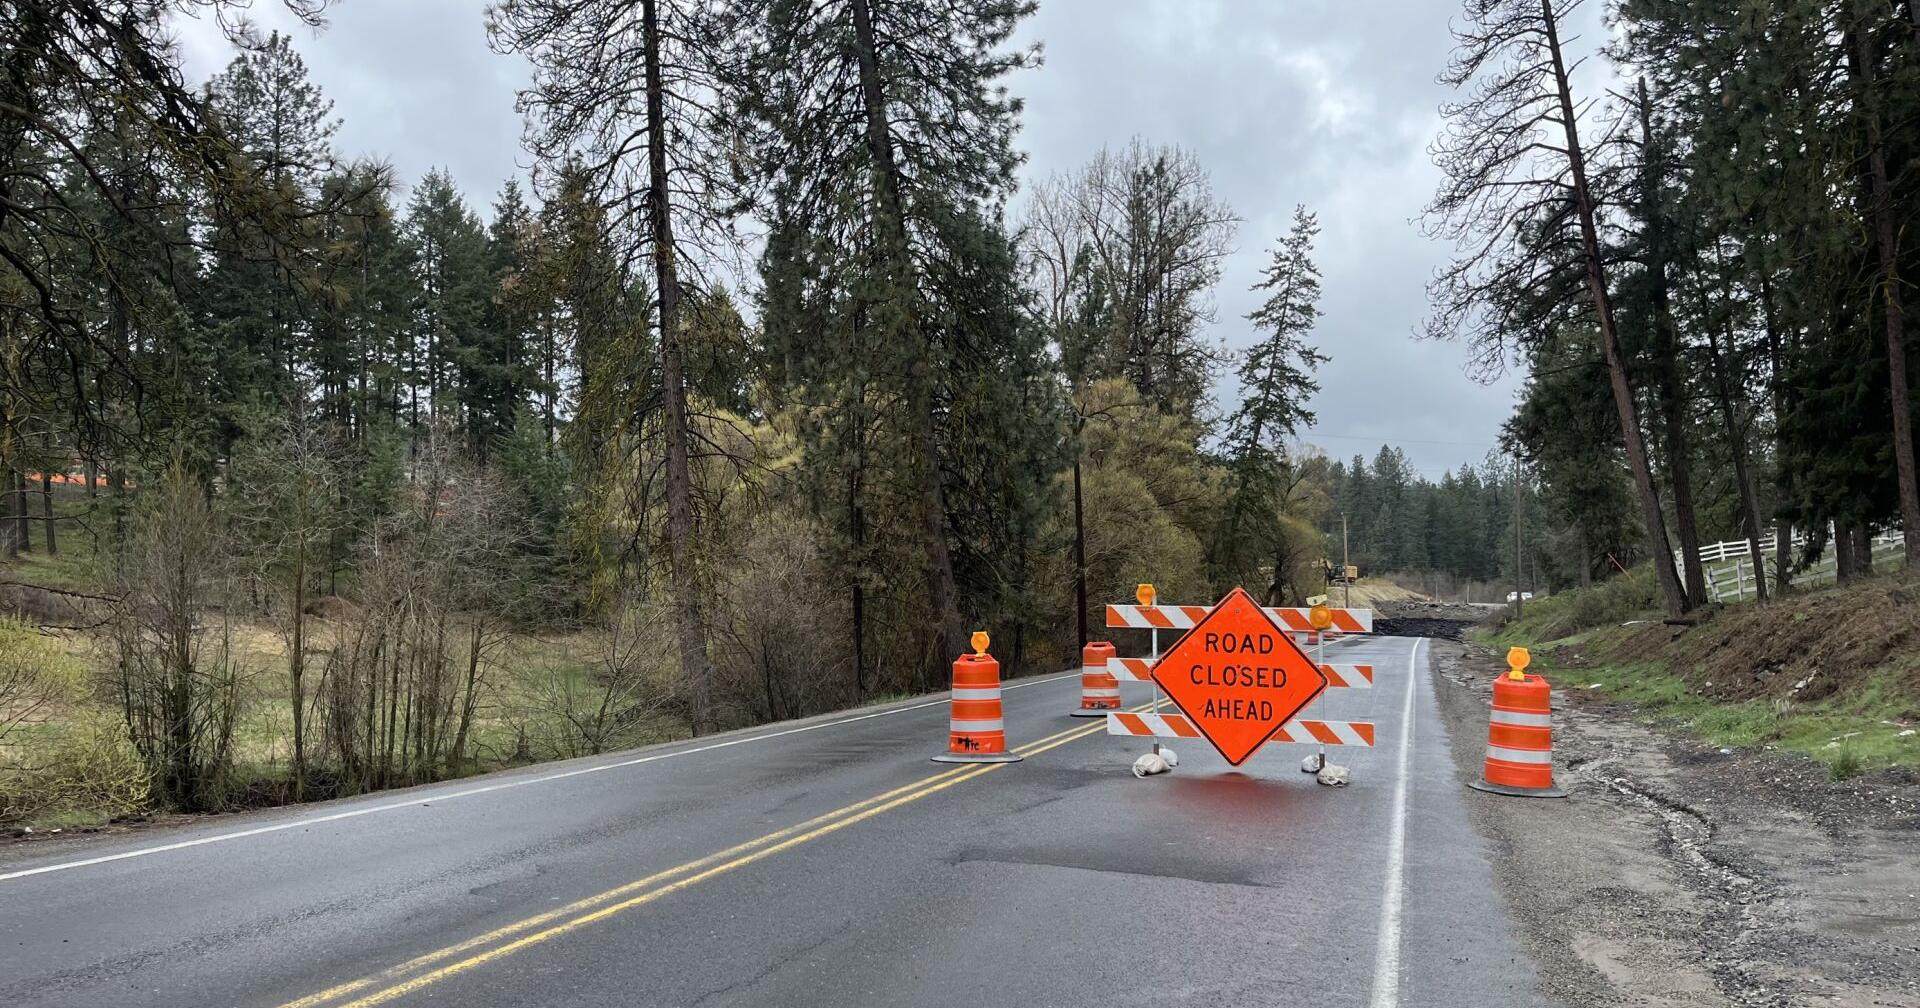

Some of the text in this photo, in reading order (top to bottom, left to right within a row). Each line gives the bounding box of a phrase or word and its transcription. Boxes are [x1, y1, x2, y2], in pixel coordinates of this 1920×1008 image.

[1205, 632, 1274, 654] ROAD
[1190, 664, 1287, 688] CLOSED
[1204, 699, 1273, 721] AHEAD
